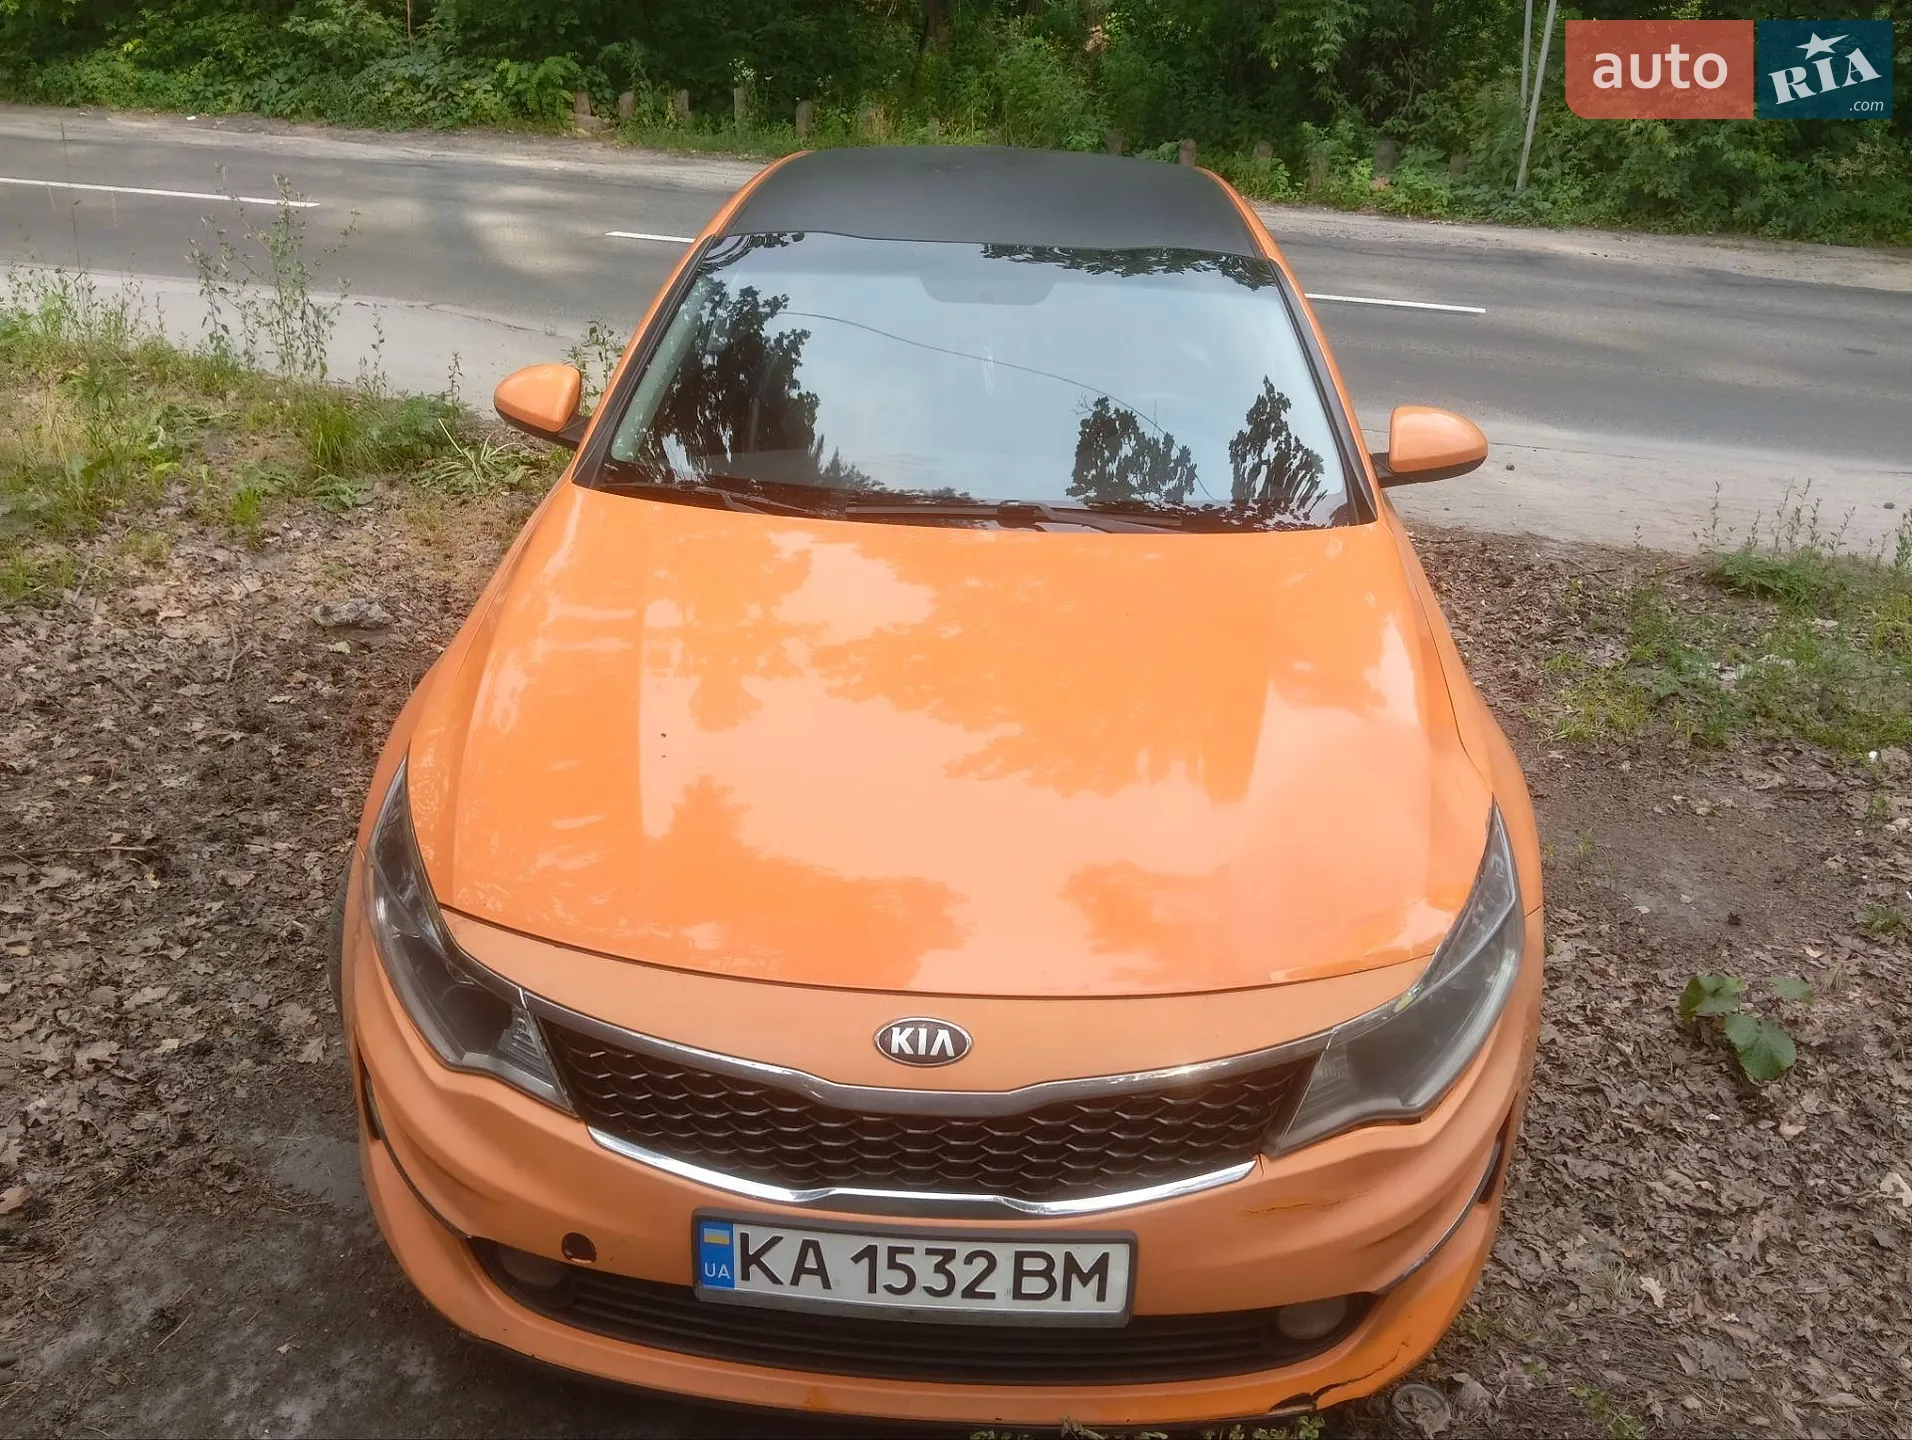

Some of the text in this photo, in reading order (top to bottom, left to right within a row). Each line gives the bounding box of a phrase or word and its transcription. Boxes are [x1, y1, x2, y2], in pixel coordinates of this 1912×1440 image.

[890, 1026, 955, 1057] KIA
[704, 1262, 731, 1280] UA
[739, 1232, 1110, 1303] KA 1532 BM
